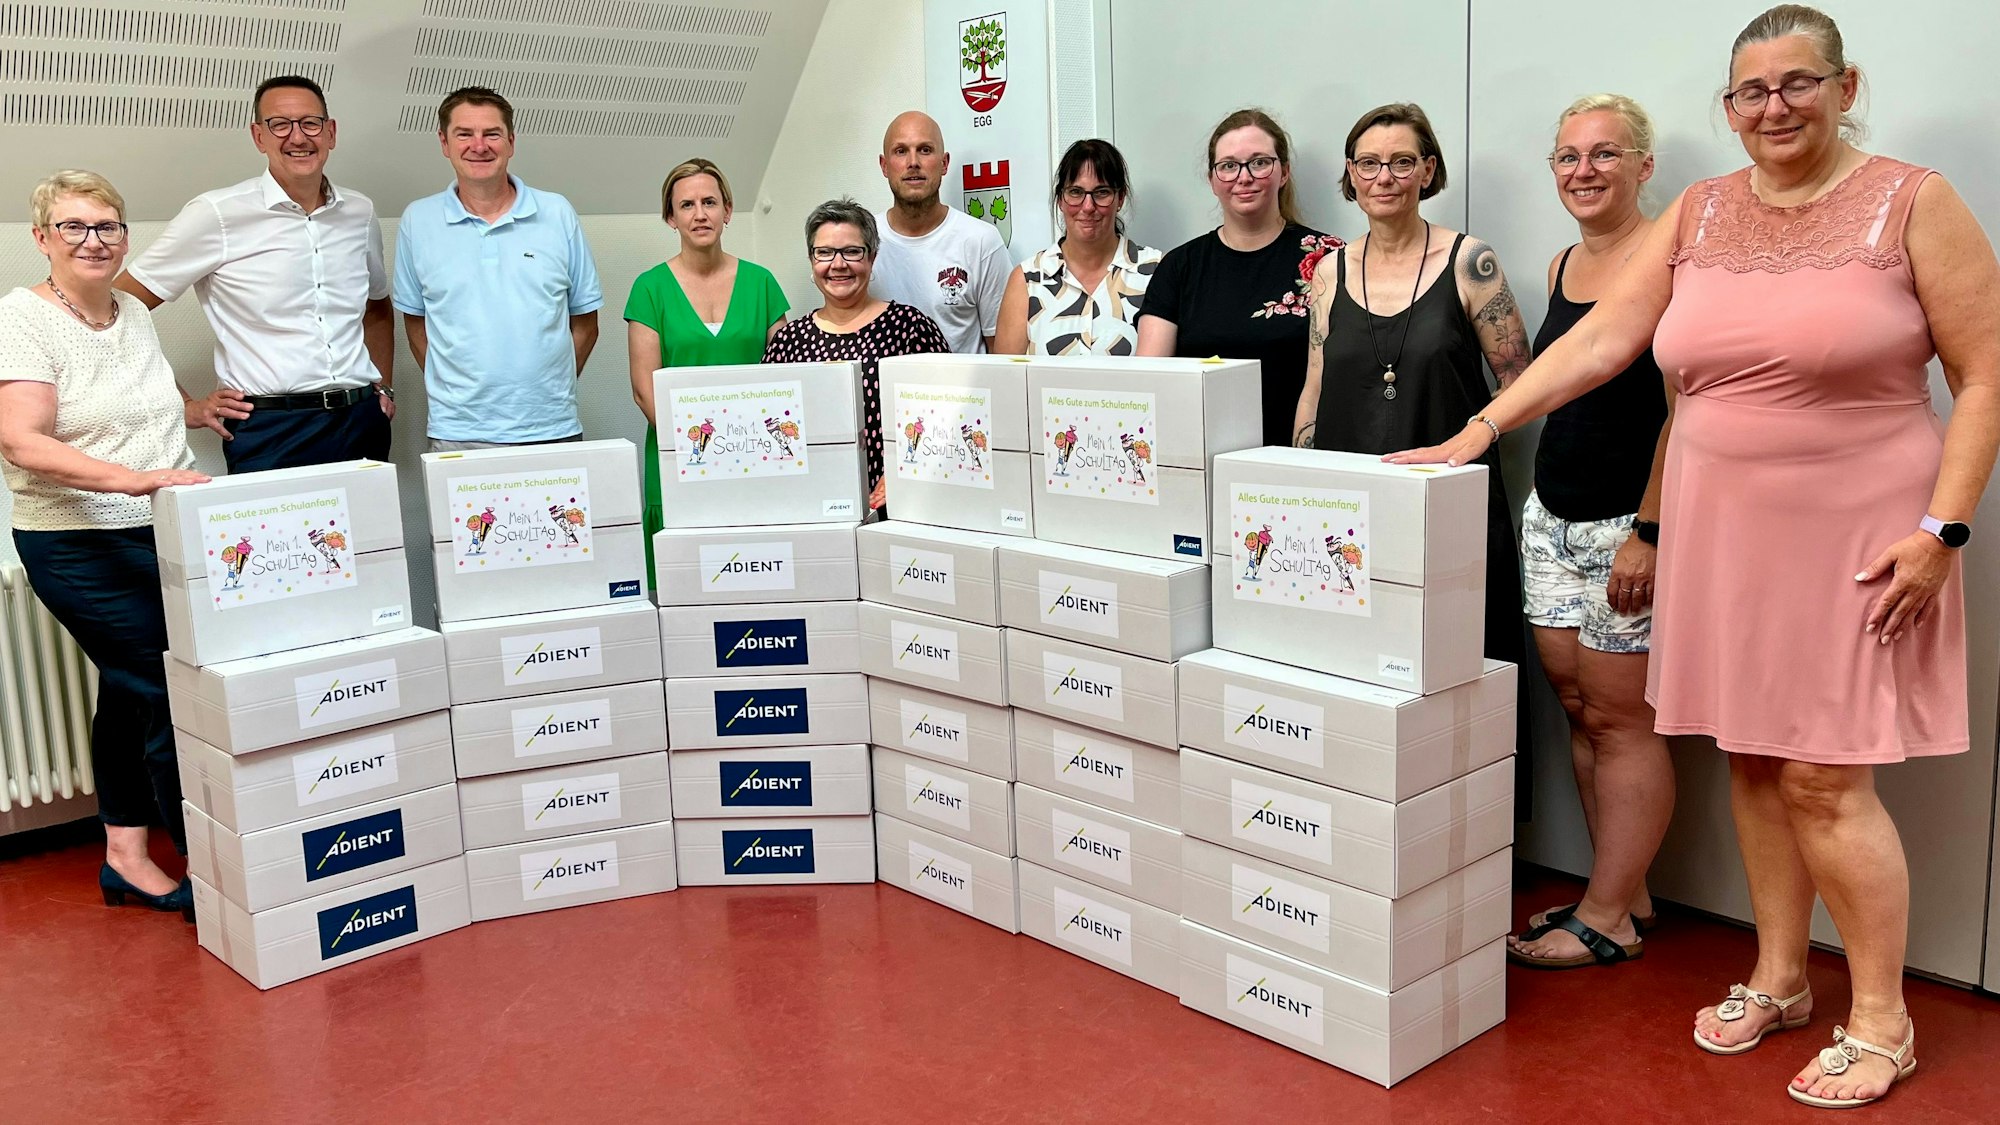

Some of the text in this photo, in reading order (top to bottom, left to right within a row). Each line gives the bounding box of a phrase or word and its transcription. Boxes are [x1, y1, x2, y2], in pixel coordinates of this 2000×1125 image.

[973, 115, 992, 128] EGG
[679, 395, 698, 403] Alles
[700, 393, 720, 402] Gute
[741, 389, 794, 399] Schulanfang!
[900, 391, 913, 399] Alles
[915, 392, 929, 400] Gute
[945, 393, 985, 406] Schulanfang!
[1048, 397, 1149, 412] Alles Gute zum Schulanfang!
[456, 483, 478, 492] Alles
[480, 482, 502, 490] Gute
[525, 476, 580, 487] Schulanfang!
[209, 497, 339, 523] Alles Gute zum Schulanfang!
[1238, 492, 1360, 513] Alles Gute zum Schulanfang!
[1006, 514, 1023, 522] ADIENT
[1178, 540, 1200, 549] ADIENT
[716, 557, 783, 578] ADIENT
[901, 563, 947, 584] ADIENT
[614, 585, 638, 594] ADIENT
[377, 610, 401, 620] ADIENT
[1052, 590, 1109, 615] ADIENT
[730, 632, 797, 654] ADIENT
[902, 639, 950, 661] ADIENT
[520, 645, 590, 670] ADIENT
[1384, 662, 1410, 673] ADIENT
[315, 680, 387, 711] ADIENT
[1057, 671, 1113, 698] ADIENT
[730, 701, 798, 723] ADIENT
[530, 716, 600, 742] ADIENT
[912, 718, 959, 742] ADIENT
[1239, 709, 1312, 741] ADIENT
[313, 756, 385, 788] ADIENT
[1066, 751, 1123, 778] ADIENT
[735, 774, 802, 794] ADIENT
[540, 790, 609, 815] ADIENT
[916, 784, 962, 810] ADIENT
[1247, 805, 1320, 837] ADIENT
[321, 829, 394, 864] ADIENT
[738, 842, 804, 862] ADIENT
[1066, 831, 1122, 861] ADIENT
[538, 858, 607, 885] ADIENT
[919, 862, 964, 890] ADIENT
[1247, 891, 1318, 926] ADIENT
[335, 905, 407, 941] ADIENT
[1067, 911, 1122, 941] ADIENT
[1242, 982, 1312, 1018] ADIENT
